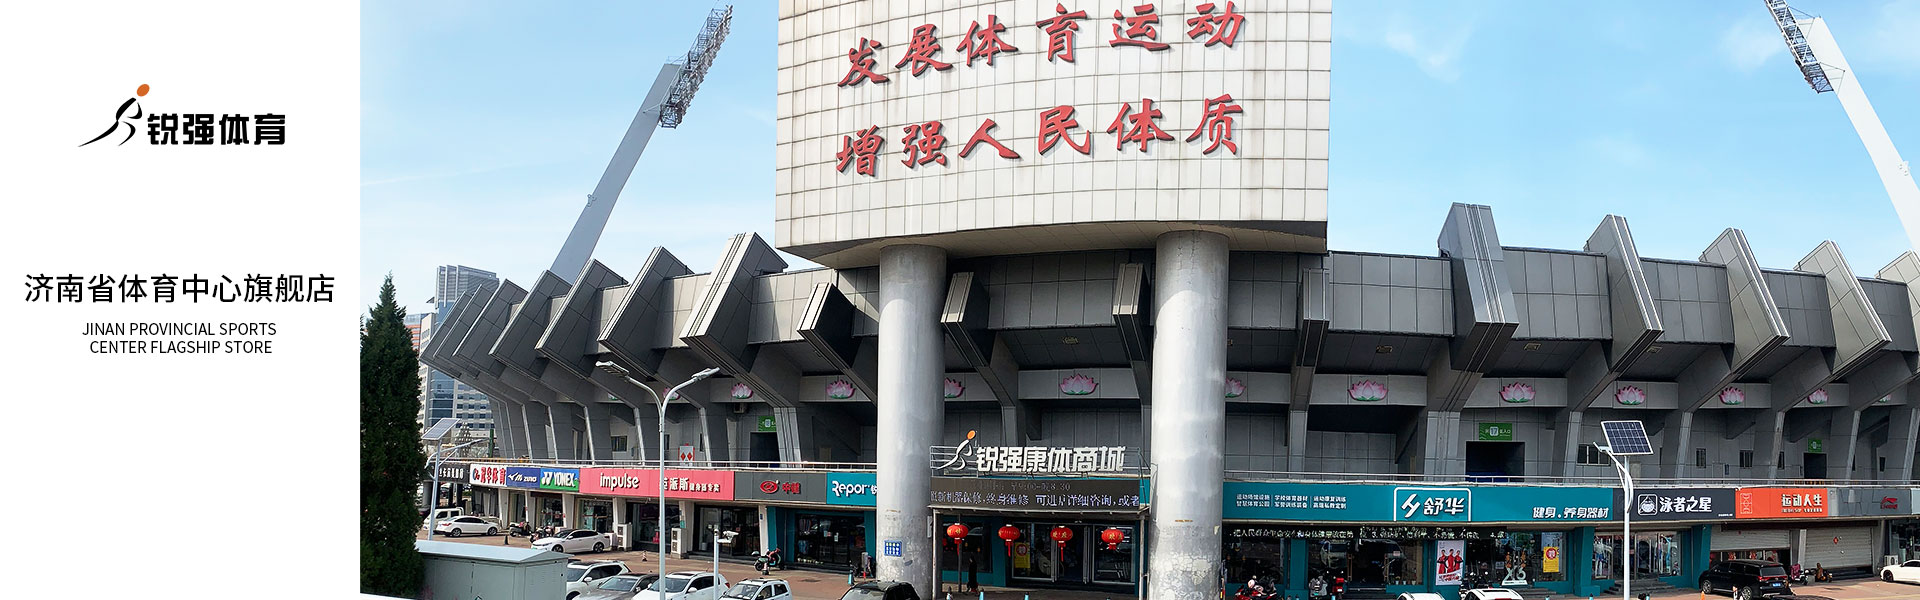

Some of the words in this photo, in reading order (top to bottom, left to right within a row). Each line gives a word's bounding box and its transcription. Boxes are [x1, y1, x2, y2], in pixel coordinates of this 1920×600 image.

[838, 1, 1246, 87] 发展体育运动
[836, 94, 1243, 177] 增强人民体质
[976, 447, 1126, 472] 锐强康体商城
[554, 472, 575, 487] YONEX
[600, 472, 639, 490] impulse
[1423, 497, 1465, 516] 舒华
[1659, 496, 1712, 513] 泳者之星
[1782, 493, 1823, 507] 运动人生
